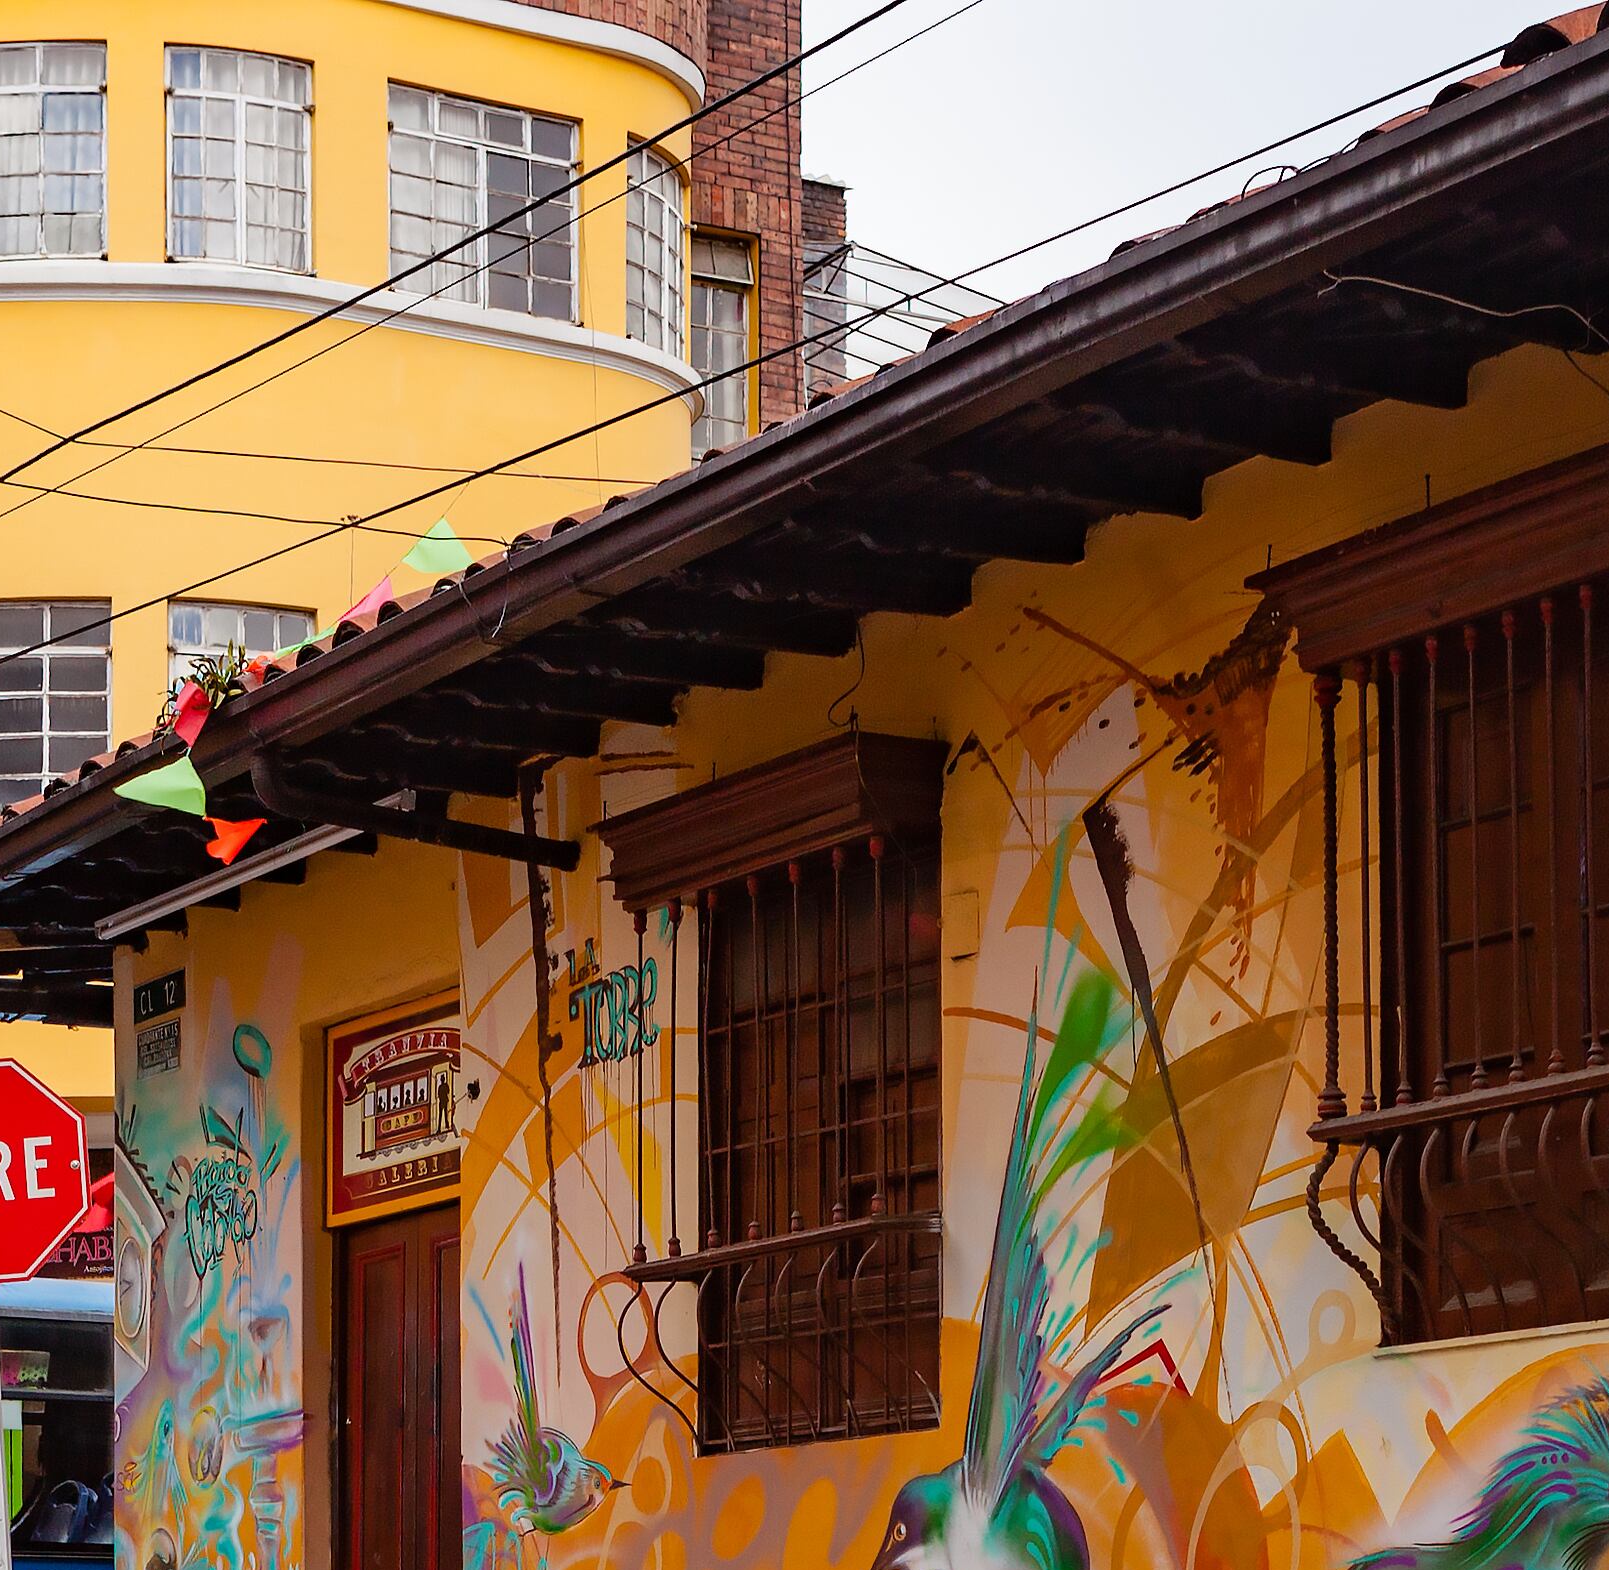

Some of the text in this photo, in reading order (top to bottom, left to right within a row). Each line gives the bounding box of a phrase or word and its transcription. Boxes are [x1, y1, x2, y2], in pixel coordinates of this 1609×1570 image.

[564, 938, 600, 986] LA
[140, 981, 176, 1015] CL 12
[361, 1032, 448, 1071] TRANVIA
